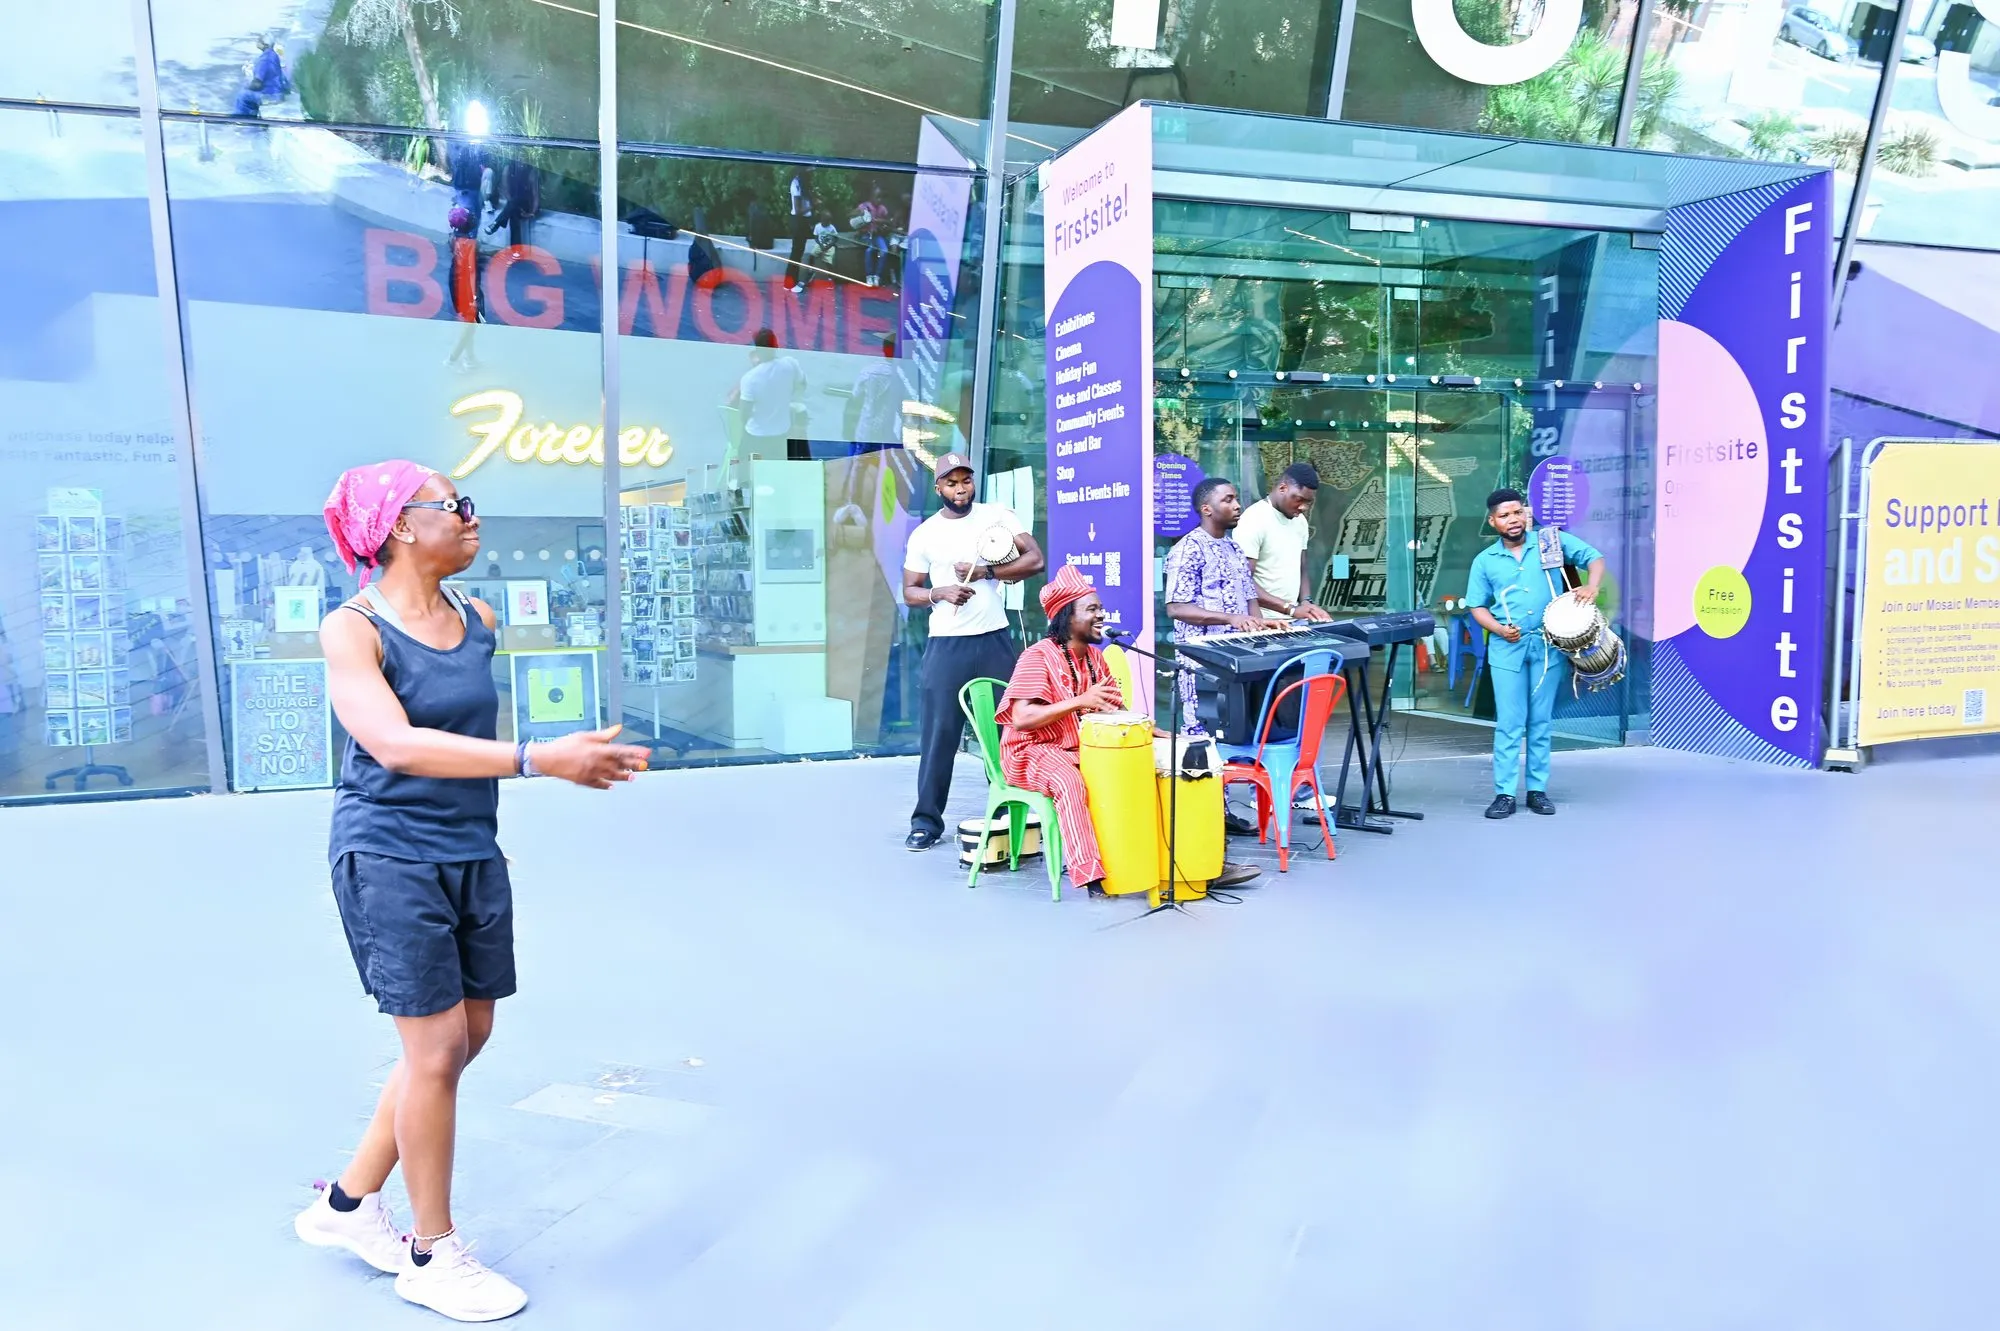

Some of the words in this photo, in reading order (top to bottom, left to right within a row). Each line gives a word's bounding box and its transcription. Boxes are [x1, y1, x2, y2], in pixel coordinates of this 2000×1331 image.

[1063, 171, 1102, 206] Welcome
[1105, 162, 1114, 179] to
[1055, 182, 1128, 256] Firstsite!
[365, 228, 565, 329] BIG
[1055, 311, 1095, 338] Exhibitions
[1055, 342, 1082, 361] Cinema
[1055, 366, 1082, 385] Holiday
[1082, 361, 1097, 377] Fun
[1056, 392, 1076, 409] Clubs
[1076, 385, 1091, 404] and
[1091, 380, 1122, 399] Classes
[1056, 410, 1097, 433] Community
[1097, 403, 1125, 423] Events
[88, 431, 131, 446] today
[1056, 440, 1073, 457] Café
[1073, 437, 1088, 454] and
[1088, 436, 1102, 451] Bar
[132, 450, 162, 462] Fun
[1665, 438, 1758, 467] Firstsite
[1056, 466, 1075, 482] Shop
[1156, 462, 1187, 471] Opening
[1547, 463, 1572, 471] Opening
[1771, 202, 1812, 731] Firstsite
[1056, 490, 1078, 505] Venue
[1079, 486, 1085, 502] &
[1085, 484, 1112, 501] Events
[1112, 482, 1130, 498] Hire
[1885, 498, 1988, 534] Support
[1066, 553, 1081, 565] Scan
[1081, 553, 1089, 565] to
[1089, 552, 1103, 565] find
[1884, 536, 1963, 586] and
[1709, 589, 1734, 601] Free
[1700, 605, 1742, 615] Admission
[1882, 601, 1903, 612] Join
[1906, 602, 1923, 611] our
[1927, 600, 1961, 611] Mosaic
[1887, 636, 1925, 645] screenings
[1929, 656, 1964, 664] workshops
[1967, 665, 1982, 673] shop
[255, 675, 307, 694] THE
[1887, 680, 1896, 688] No
[1898, 679, 1925, 688] booking
[245, 696, 318, 709] COURAGE
[1877, 708, 1899, 719] Join
[1902, 706, 1925, 717] here
[1928, 704, 1957, 716] today
[265, 710, 300, 731] TO
[257, 732, 307, 753] SAY
[260, 754, 306, 775] NO!
